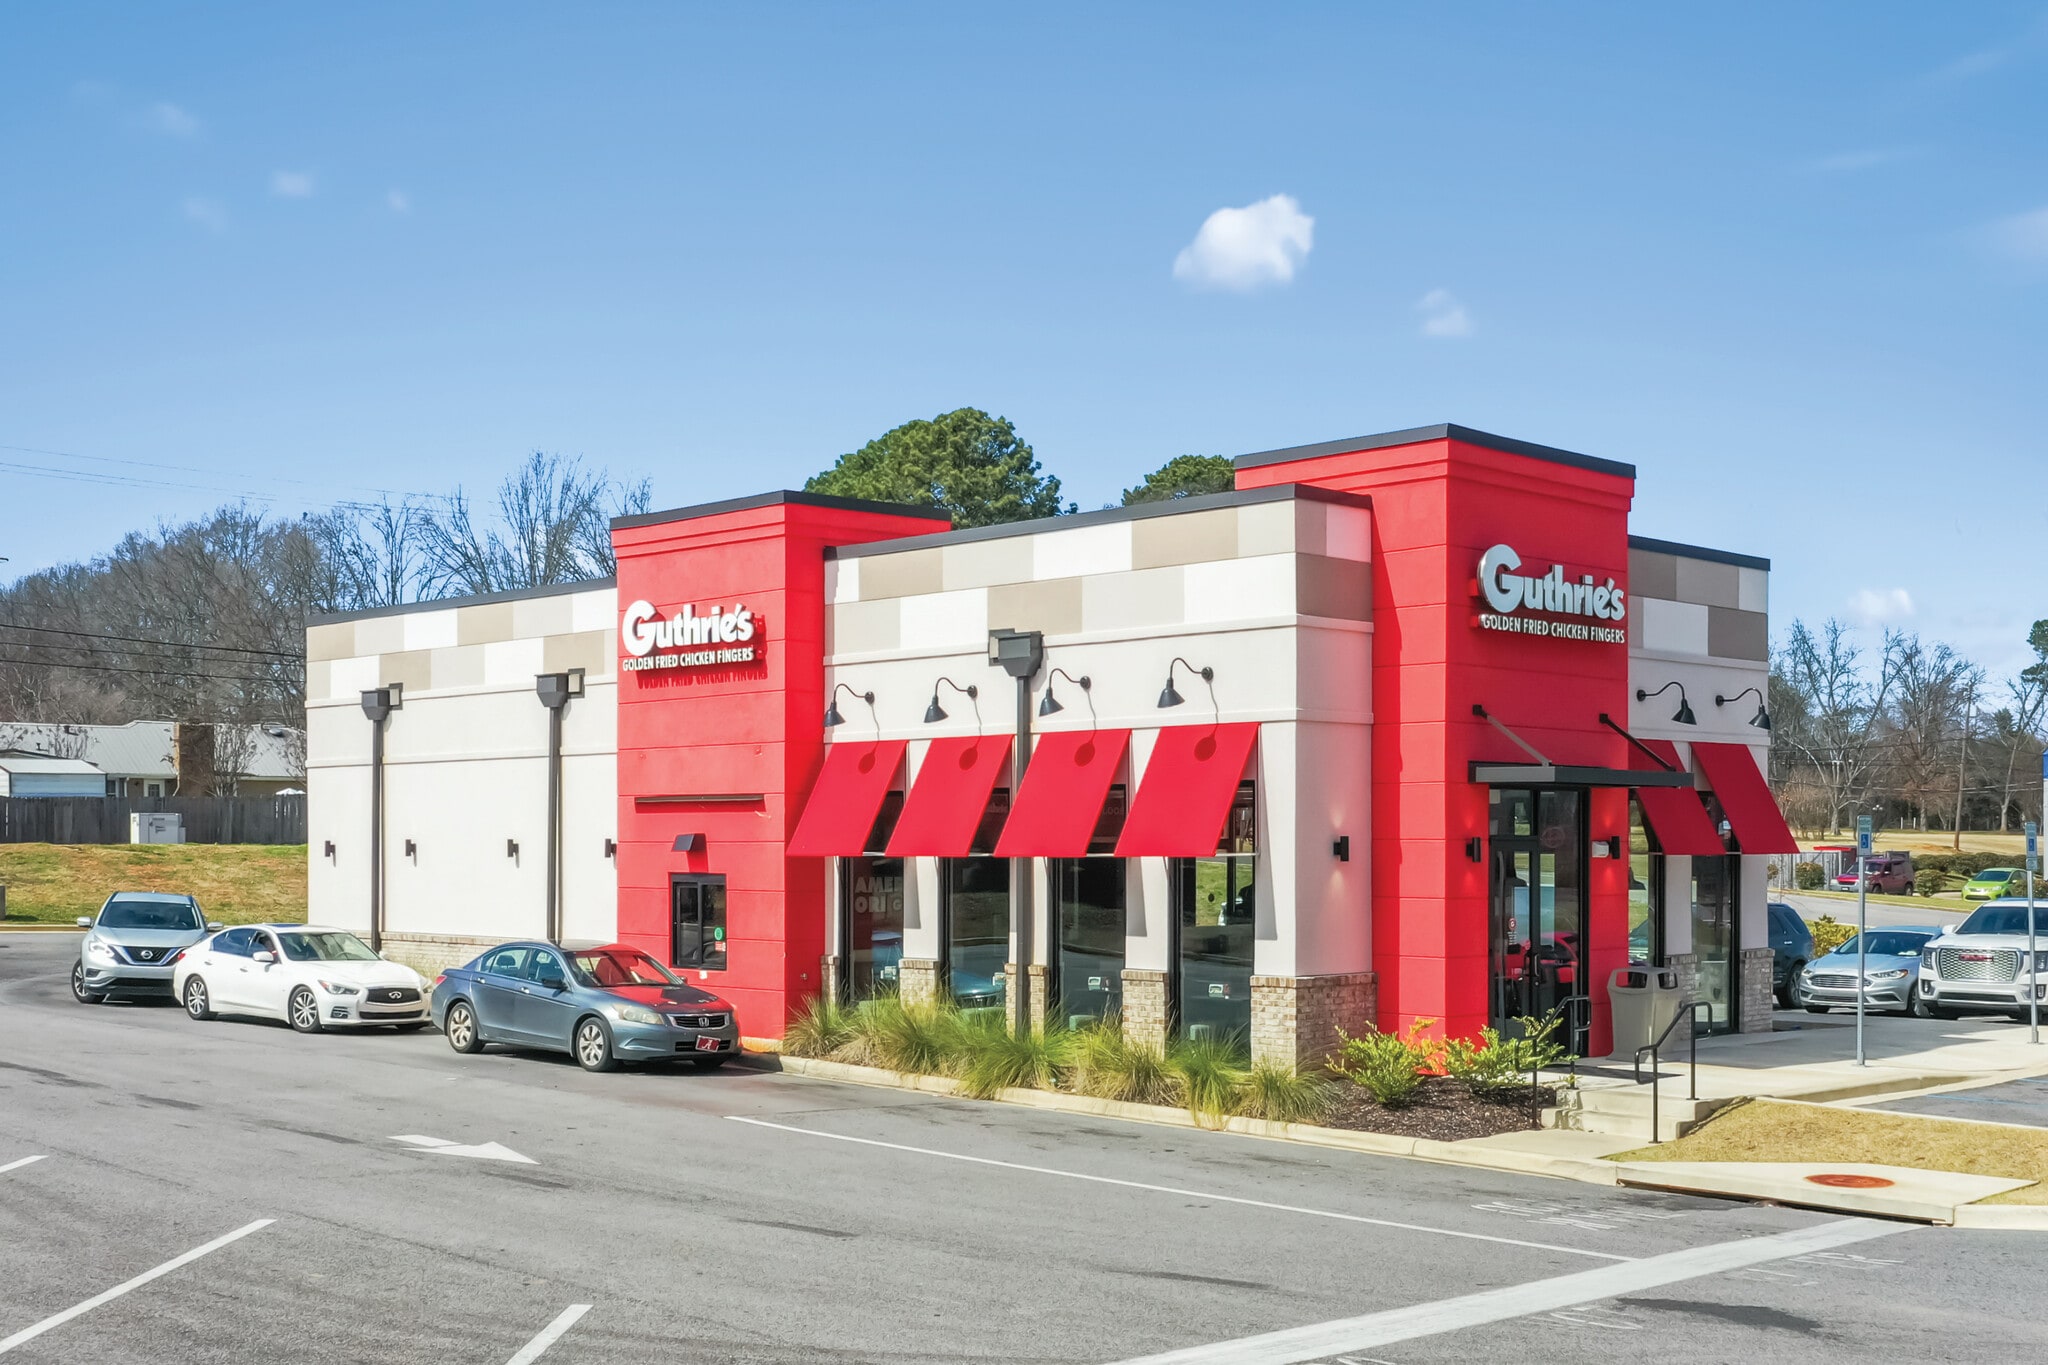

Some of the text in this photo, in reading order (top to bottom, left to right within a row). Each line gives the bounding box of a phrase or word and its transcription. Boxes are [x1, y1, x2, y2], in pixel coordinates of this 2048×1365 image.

[1477, 544, 1625, 621] Guthrie's
[622, 600, 754, 656] Guthrie's
[1481, 614, 1625, 644] GOLDEN FRIED CHICKEN FINGERS
[622, 647, 754, 671] GOLDEN FRIED CHICKEN FINGERS
